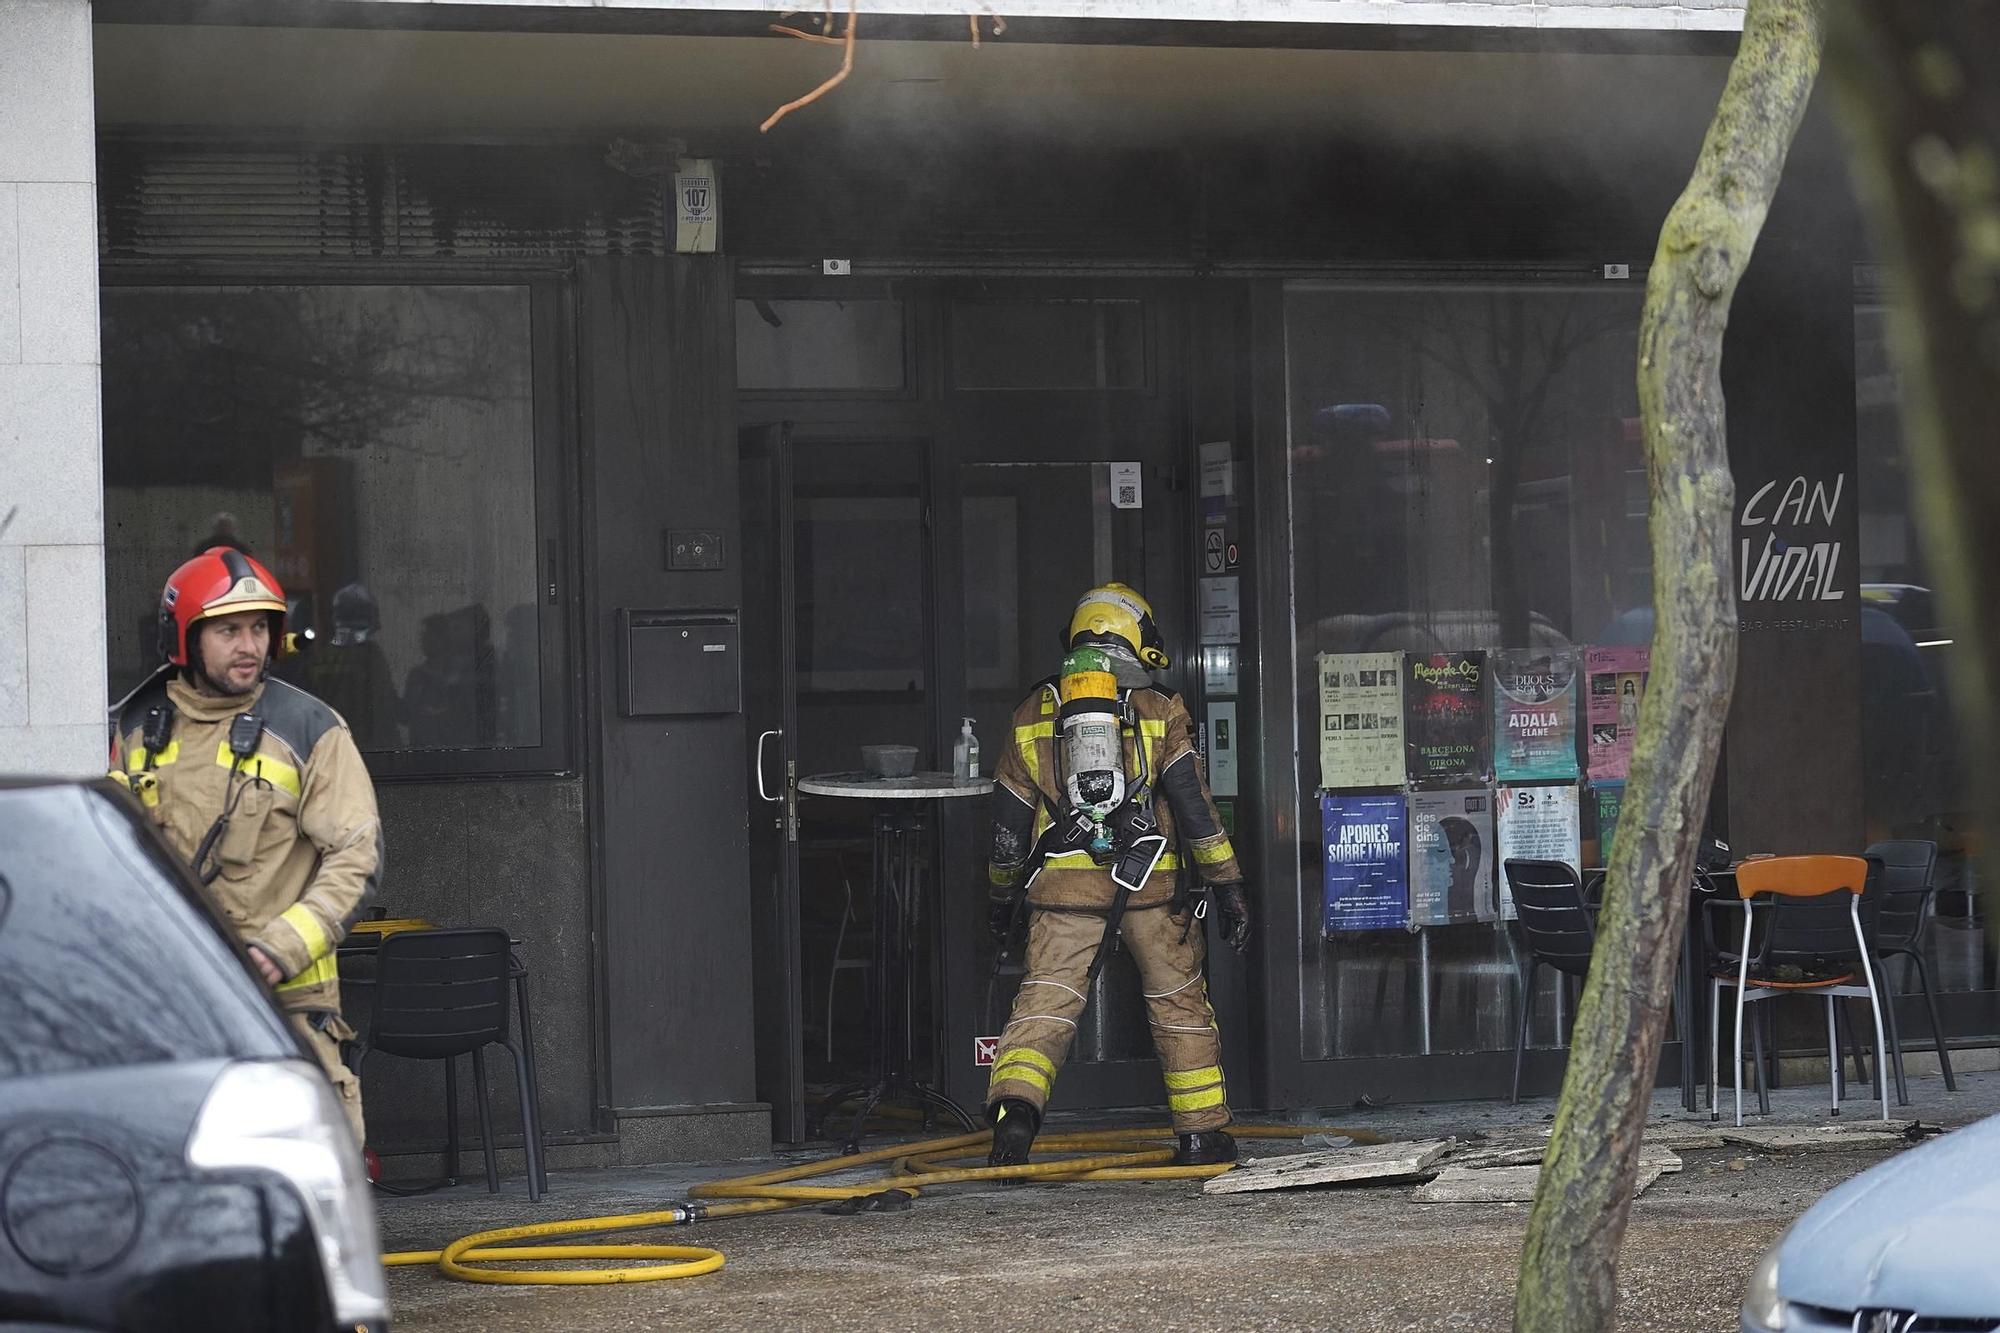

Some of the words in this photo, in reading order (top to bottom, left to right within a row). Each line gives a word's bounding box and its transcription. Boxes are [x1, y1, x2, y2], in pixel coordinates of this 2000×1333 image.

[685, 189, 707, 207] 107
[1741, 473, 1844, 526] CAN
[1508, 712, 1558, 728] ADALA
[1521, 727, 1549, 737] ELANE
[1420, 745, 1475, 755] BARCELONA
[1429, 758, 1466, 767] GIRONA
[1416, 812, 1436, 823] des
[1415, 822, 1430, 832] de
[1340, 823, 1390, 844] APORIES
[1416, 831, 1440, 842] dins
[1327, 842, 1367, 863] SOBRE
[1367, 841, 1401, 861] L'AIRE
